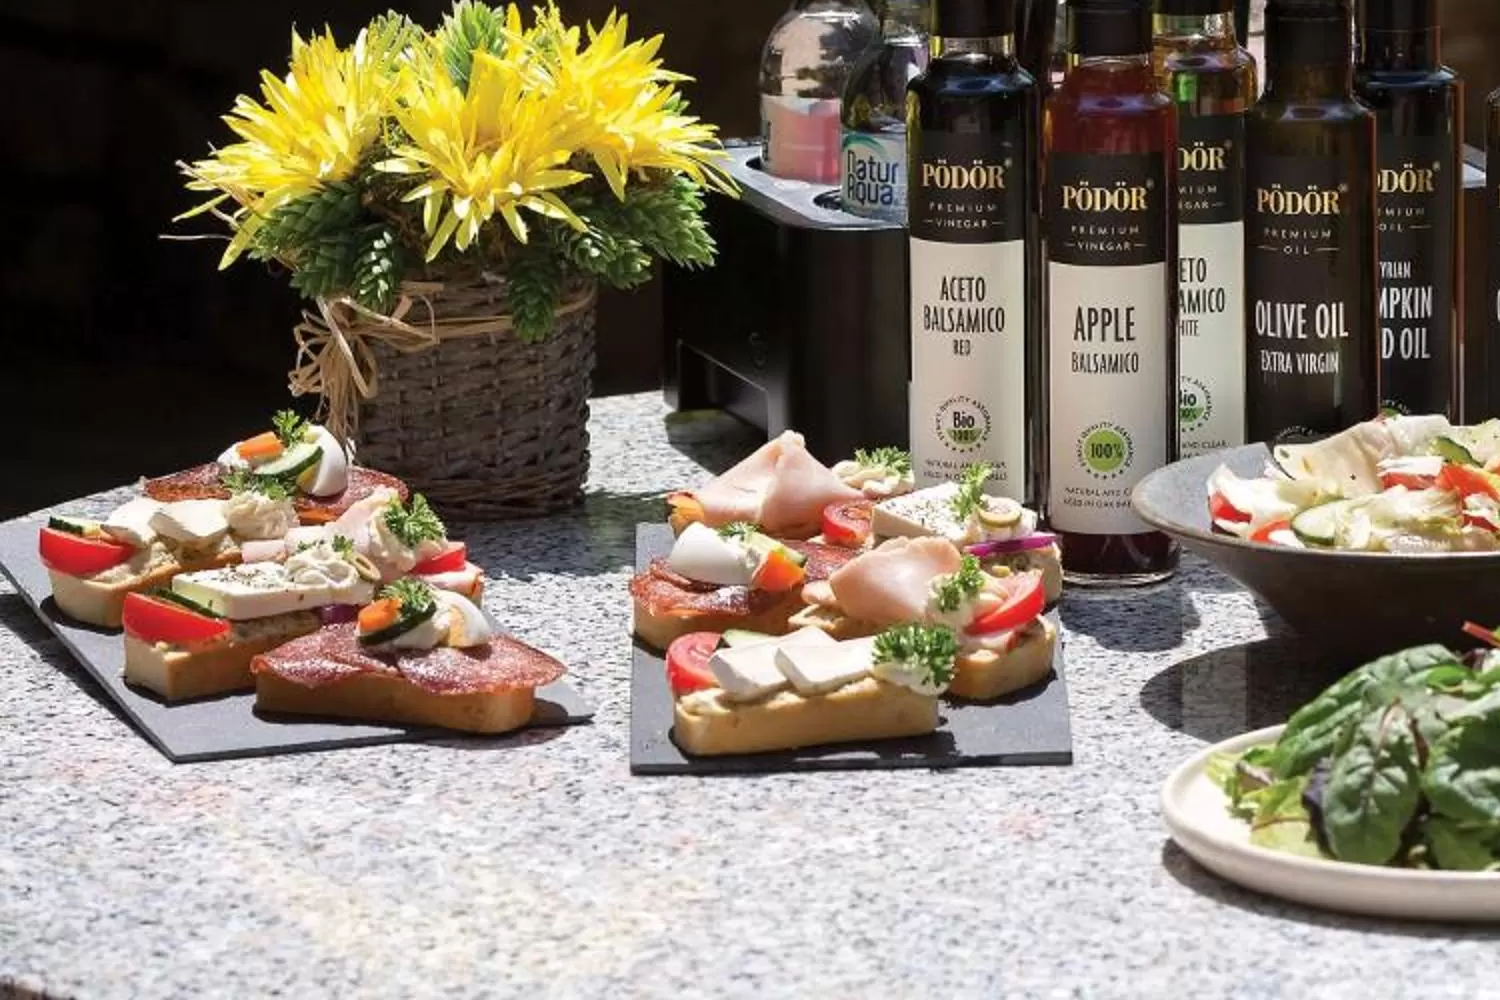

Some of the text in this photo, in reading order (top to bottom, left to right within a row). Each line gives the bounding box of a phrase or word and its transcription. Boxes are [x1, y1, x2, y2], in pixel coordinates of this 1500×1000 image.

[1178, 141, 1226, 171] DÖR
[922, 159, 1006, 189] PÖDÖR
[1379, 163, 1434, 193] DÖR
[929, 202, 998, 213] PREMIUM
[1061, 180, 1149, 212] PÖDÖR
[1257, 183, 1340, 215] PÖDÖR
[935, 218, 988, 229] VINEGAR
[1071, 224, 1139, 235] PREMIUM
[1263, 227, 1332, 239] PREMIUM
[1077, 240, 1131, 251] VINEGAR
[1283, 245, 1309, 255] OIL
[1179, 257, 1207, 283] ETO
[940, 275, 986, 302] ACETO
[1179, 287, 1226, 314] AMICO
[923, 304, 1006, 333] BALSAMICO
[1073, 305, 1136, 342] APPLE
[1178, 319, 1200, 337] HITE
[1255, 300, 1349, 339] OLIVE OIL
[953, 339, 971, 356] RED
[1400, 327, 1431, 360] OIL
[1071, 351, 1139, 374] BALSAMICO
[1260, 349, 1339, 374] EXTRA VIRGIN
[1179, 389, 1197, 406] io
[953, 410, 975, 428] Bio
[1091, 442, 1123, 459] 100%
